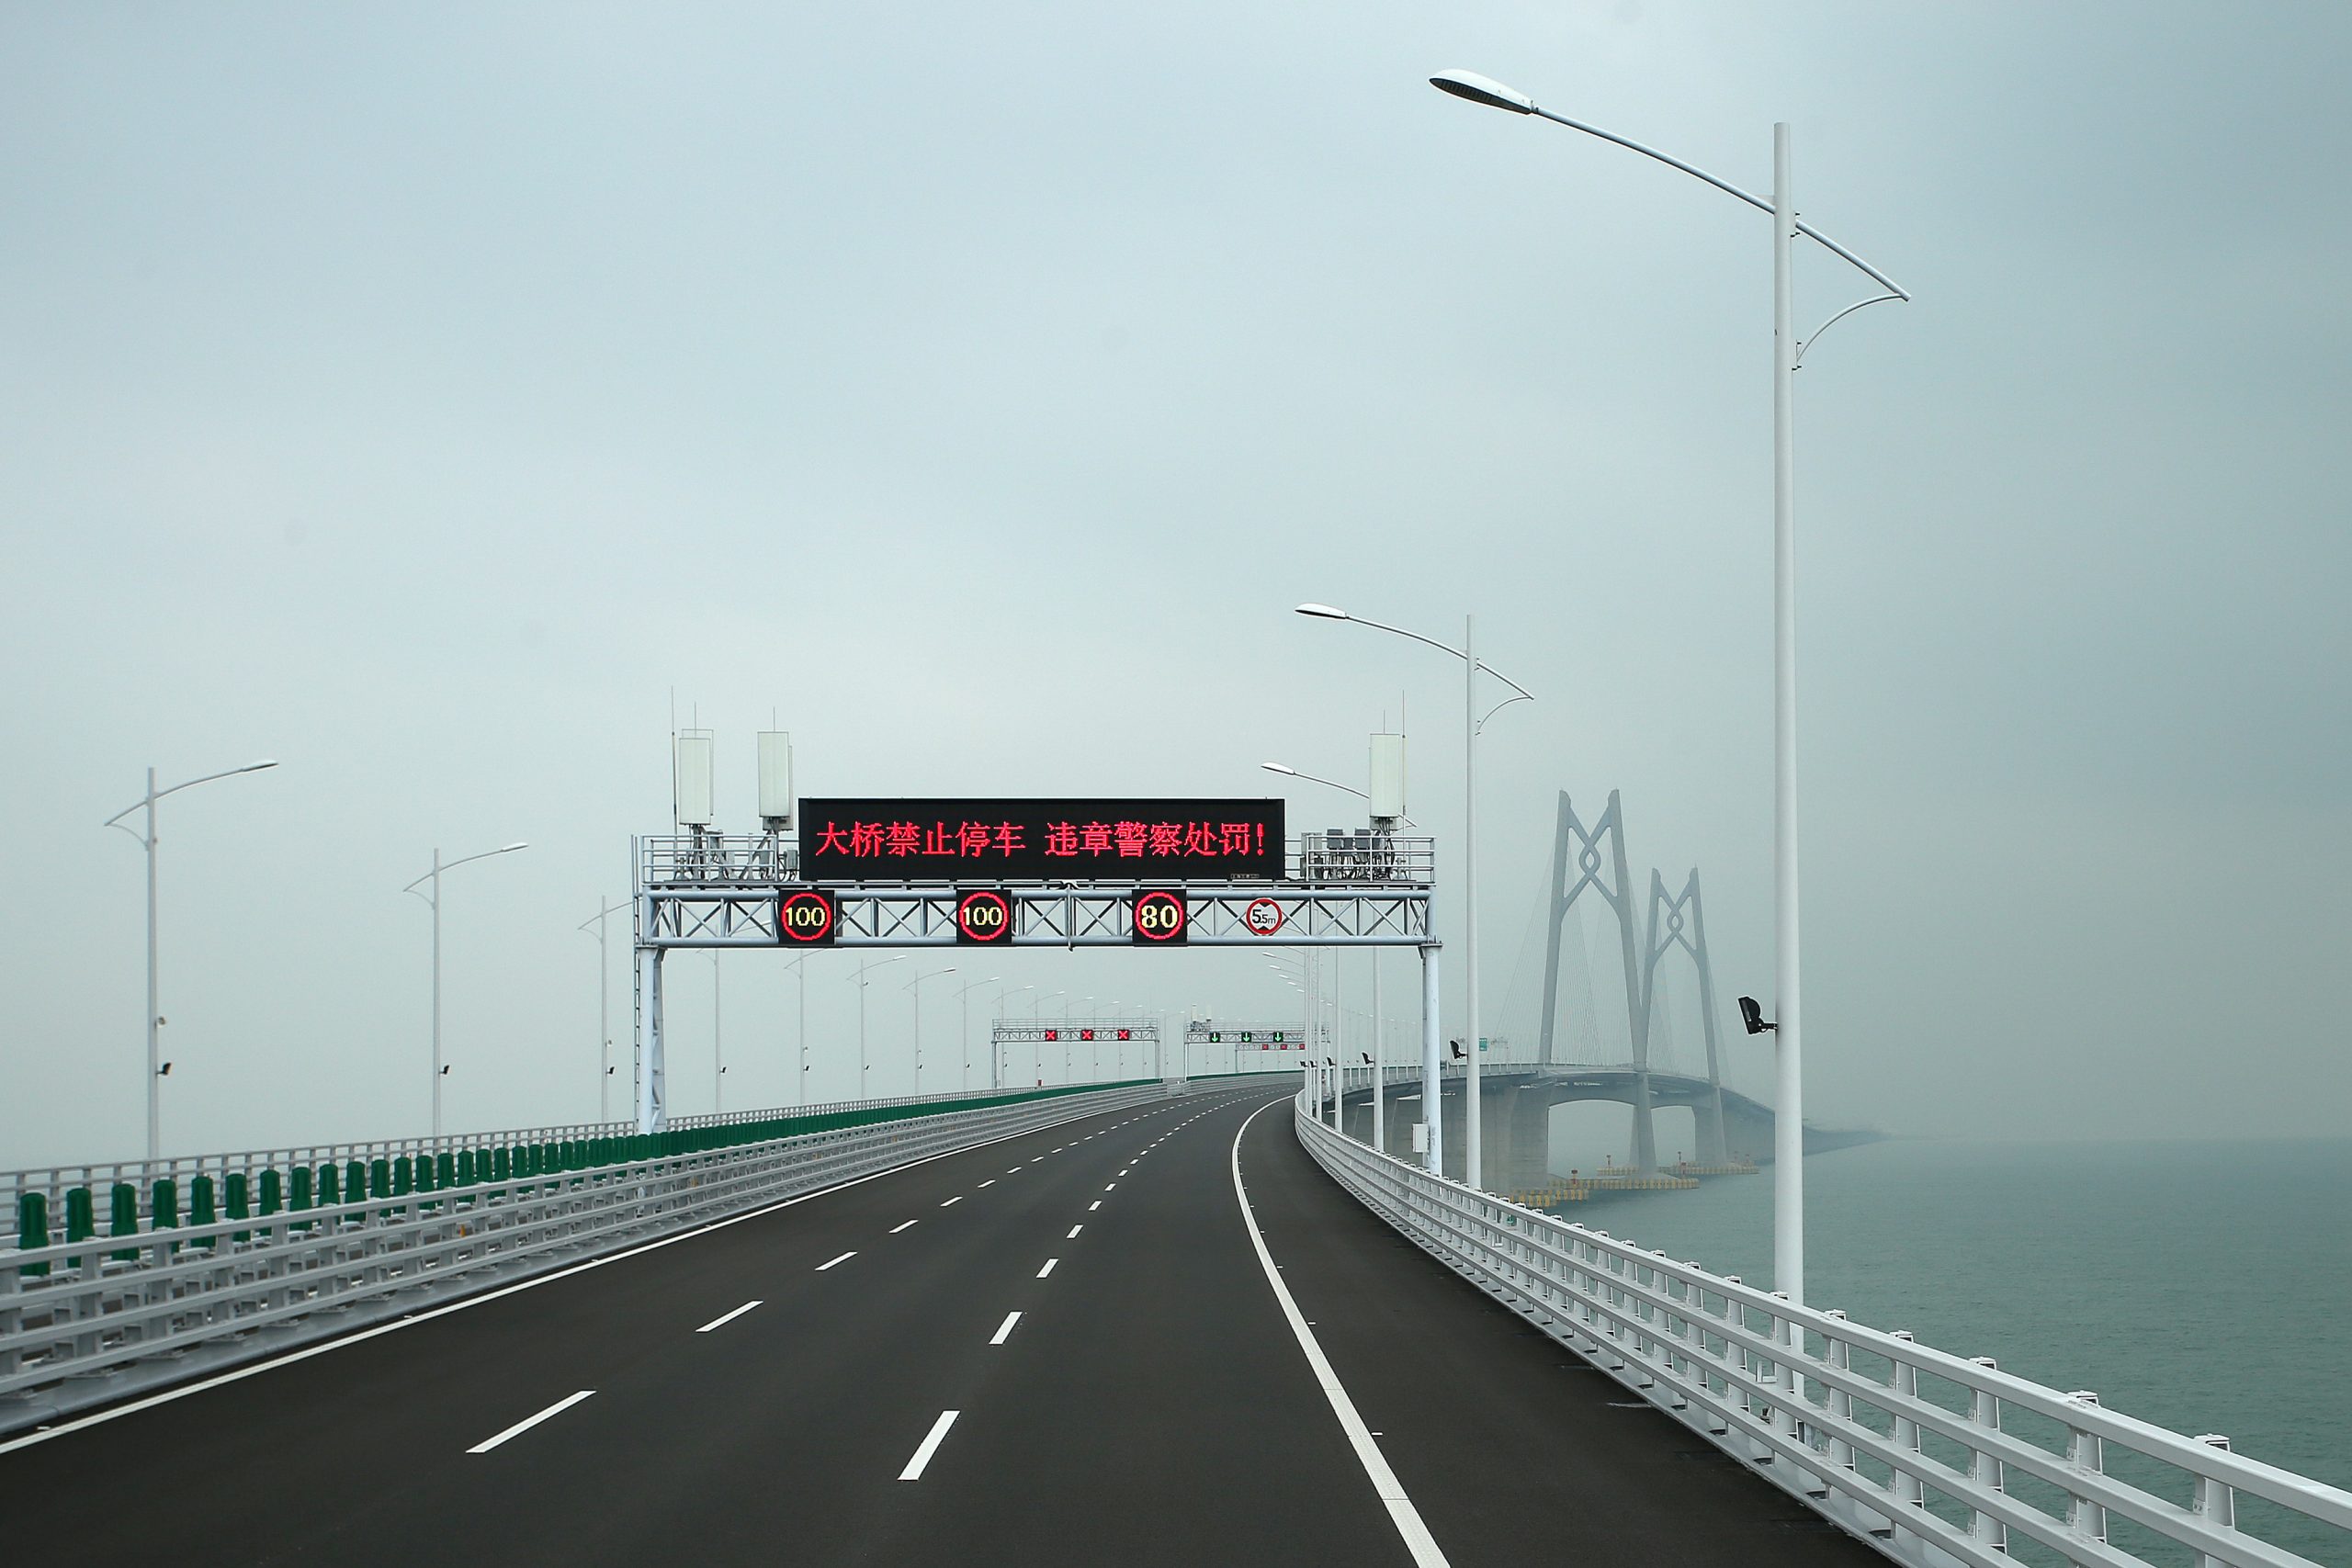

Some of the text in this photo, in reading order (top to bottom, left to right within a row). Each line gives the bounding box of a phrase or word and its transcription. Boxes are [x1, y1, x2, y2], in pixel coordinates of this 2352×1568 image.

[815, 820, 1265, 858] 大桥禁止停车 违章警察处罚!
[785, 907, 826, 927] 100
[963, 907, 1003, 926] 100
[1141, 906, 1179, 928] 80
[1251, 908, 1276, 924] 5.5m
